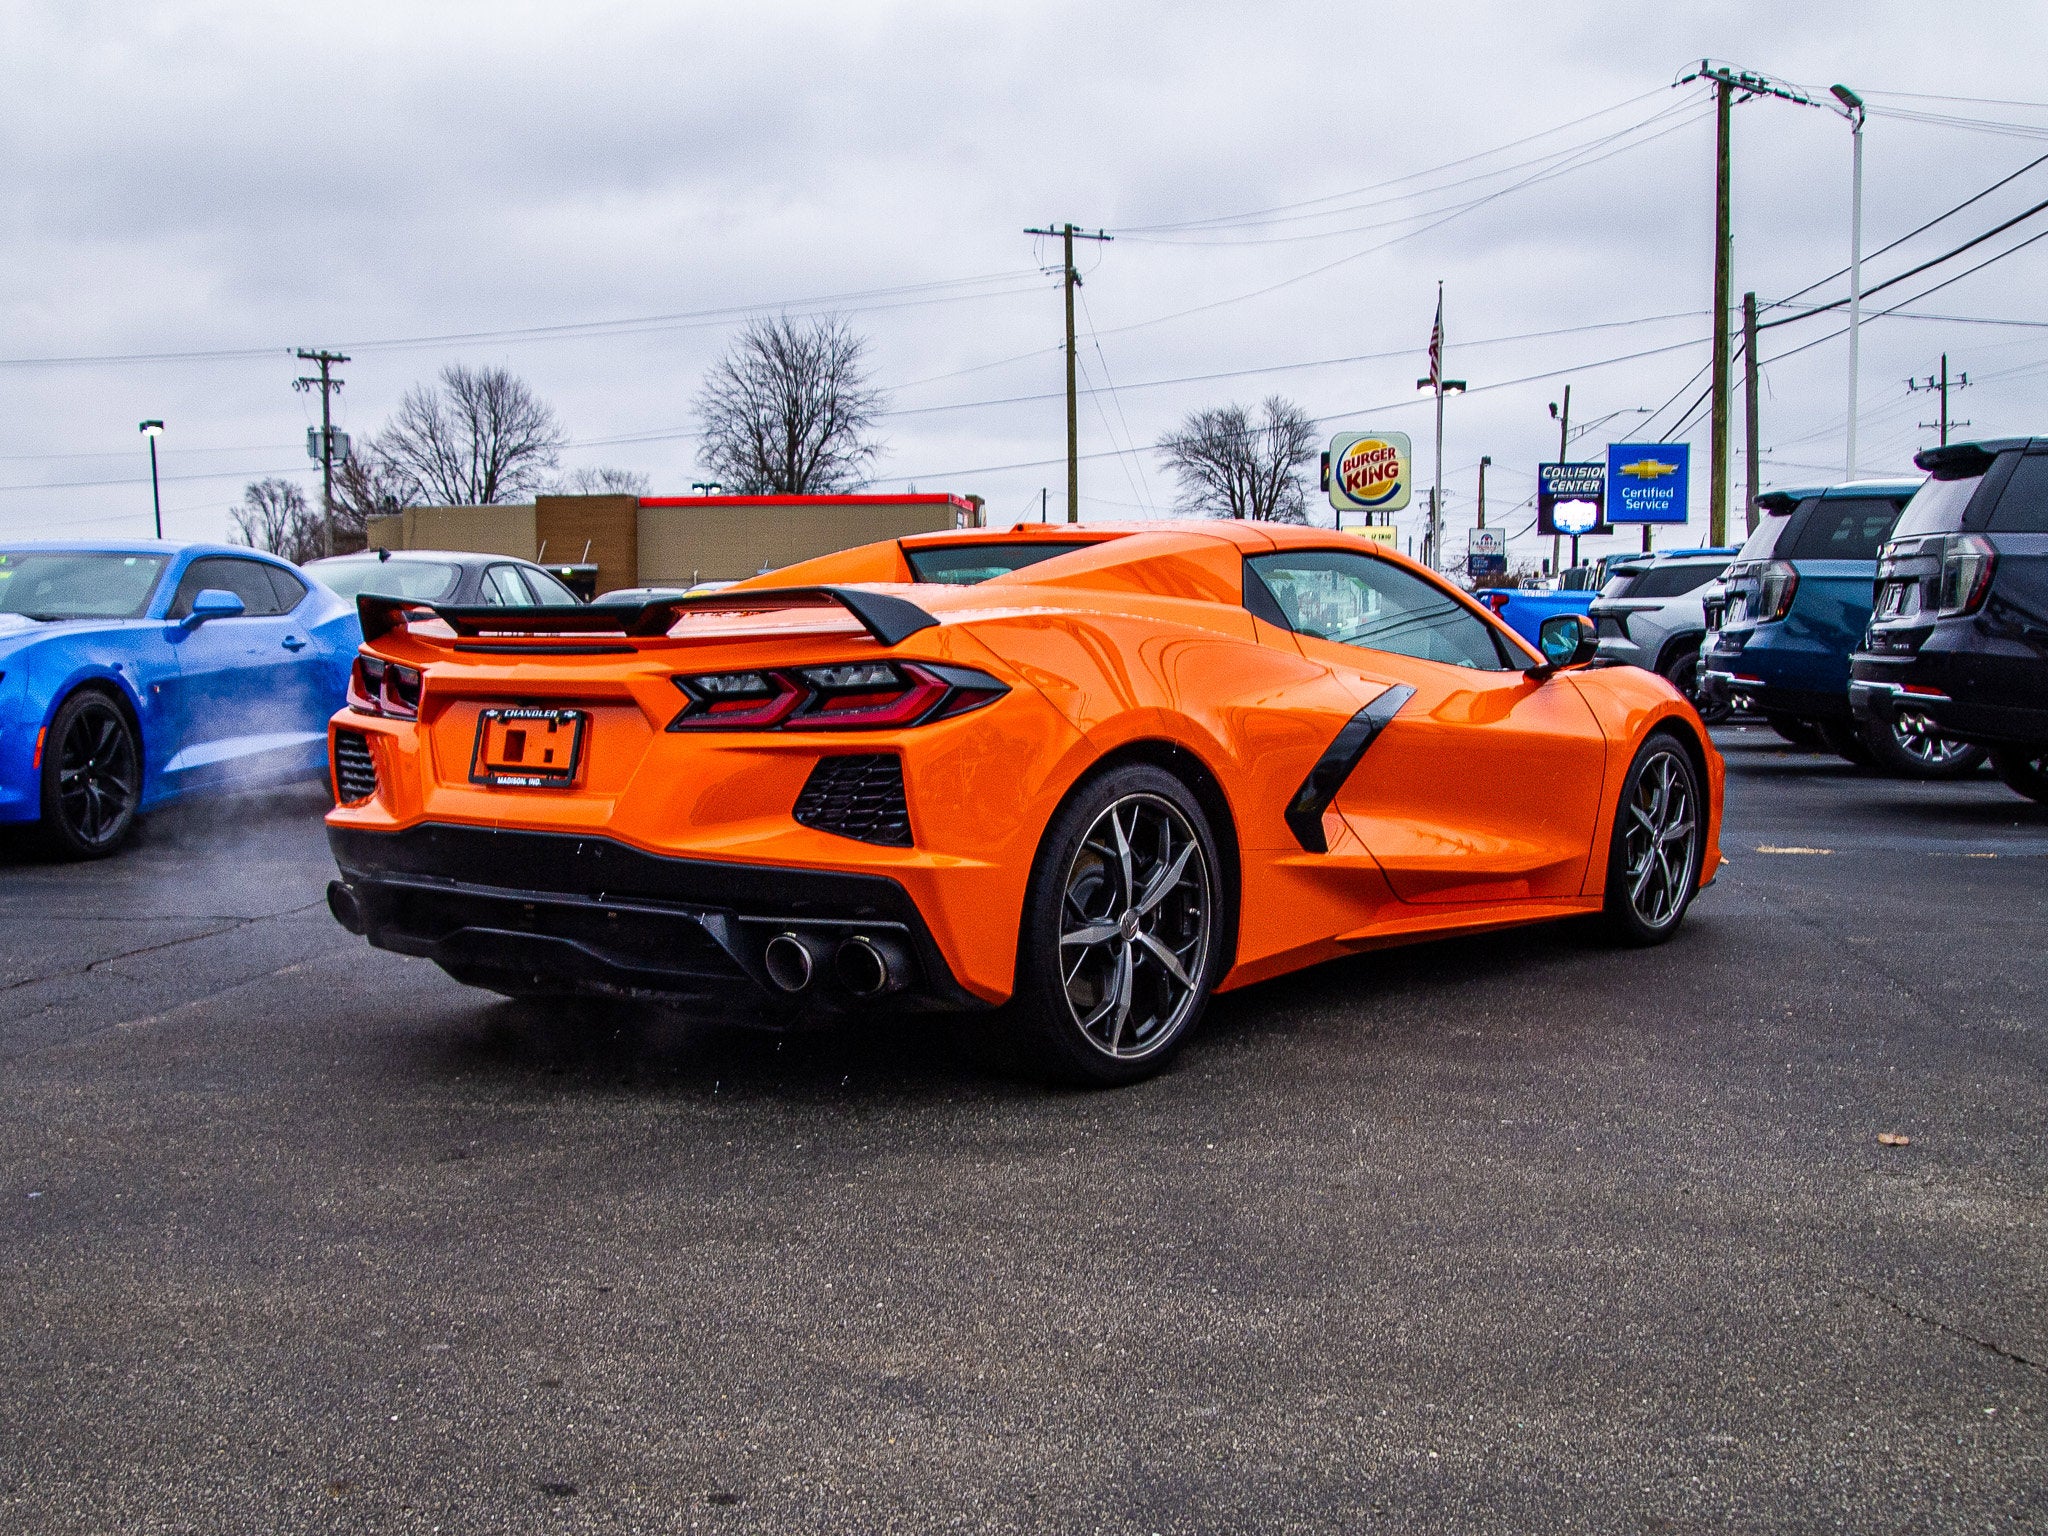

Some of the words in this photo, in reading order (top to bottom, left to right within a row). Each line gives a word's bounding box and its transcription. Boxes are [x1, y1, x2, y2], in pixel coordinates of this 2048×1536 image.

[1343, 447, 1396, 473] BURGER
[1346, 460, 1399, 493] KING
[1549, 479, 1600, 492] CENTER
[1622, 487, 1674, 498] Certified
[1625, 499, 1669, 509] Service
[504, 709, 558, 718] CHANDLER
